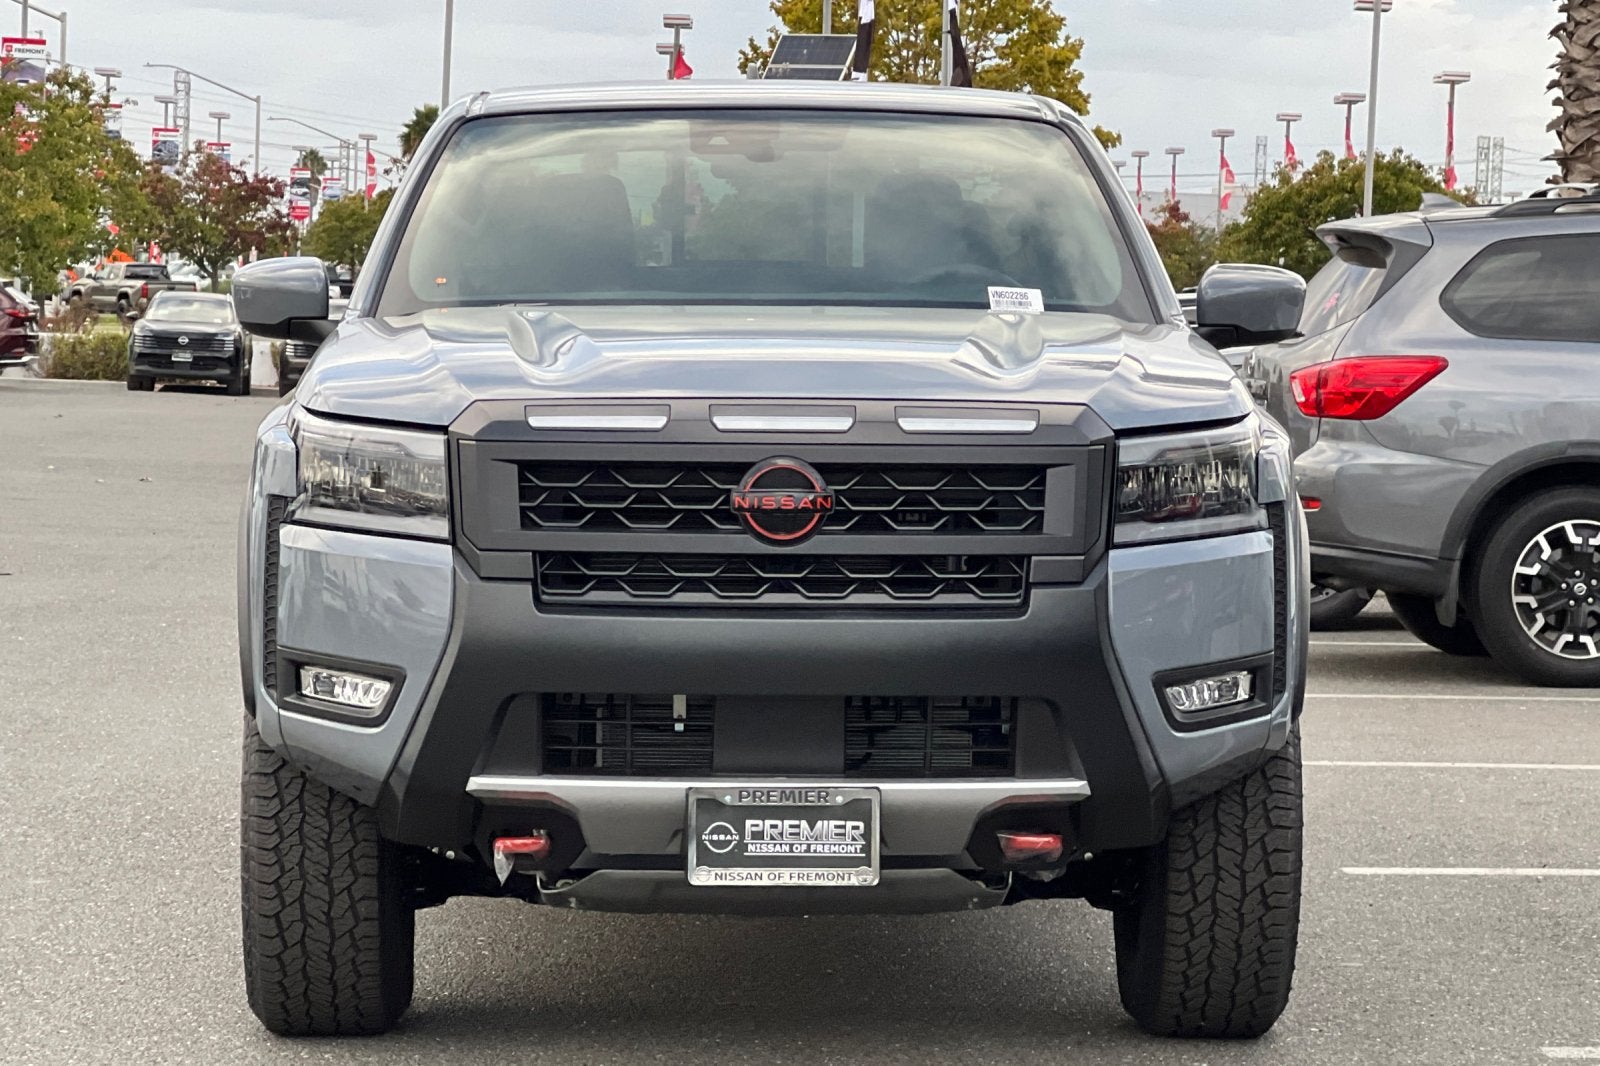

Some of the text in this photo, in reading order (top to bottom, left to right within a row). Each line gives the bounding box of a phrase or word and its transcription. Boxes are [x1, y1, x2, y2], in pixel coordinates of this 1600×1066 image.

[14, 47, 45, 55] FREMONT
[991, 290, 1029, 300] VN602286
[734, 496, 831, 509] NISSAN
[738, 790, 830, 804] PREMIER
[745, 819, 865, 842] PREMIER
[747, 843, 863, 854] NISSAN OF FREMONT
[714, 871, 854, 882] NISSAN OF FREMONT
